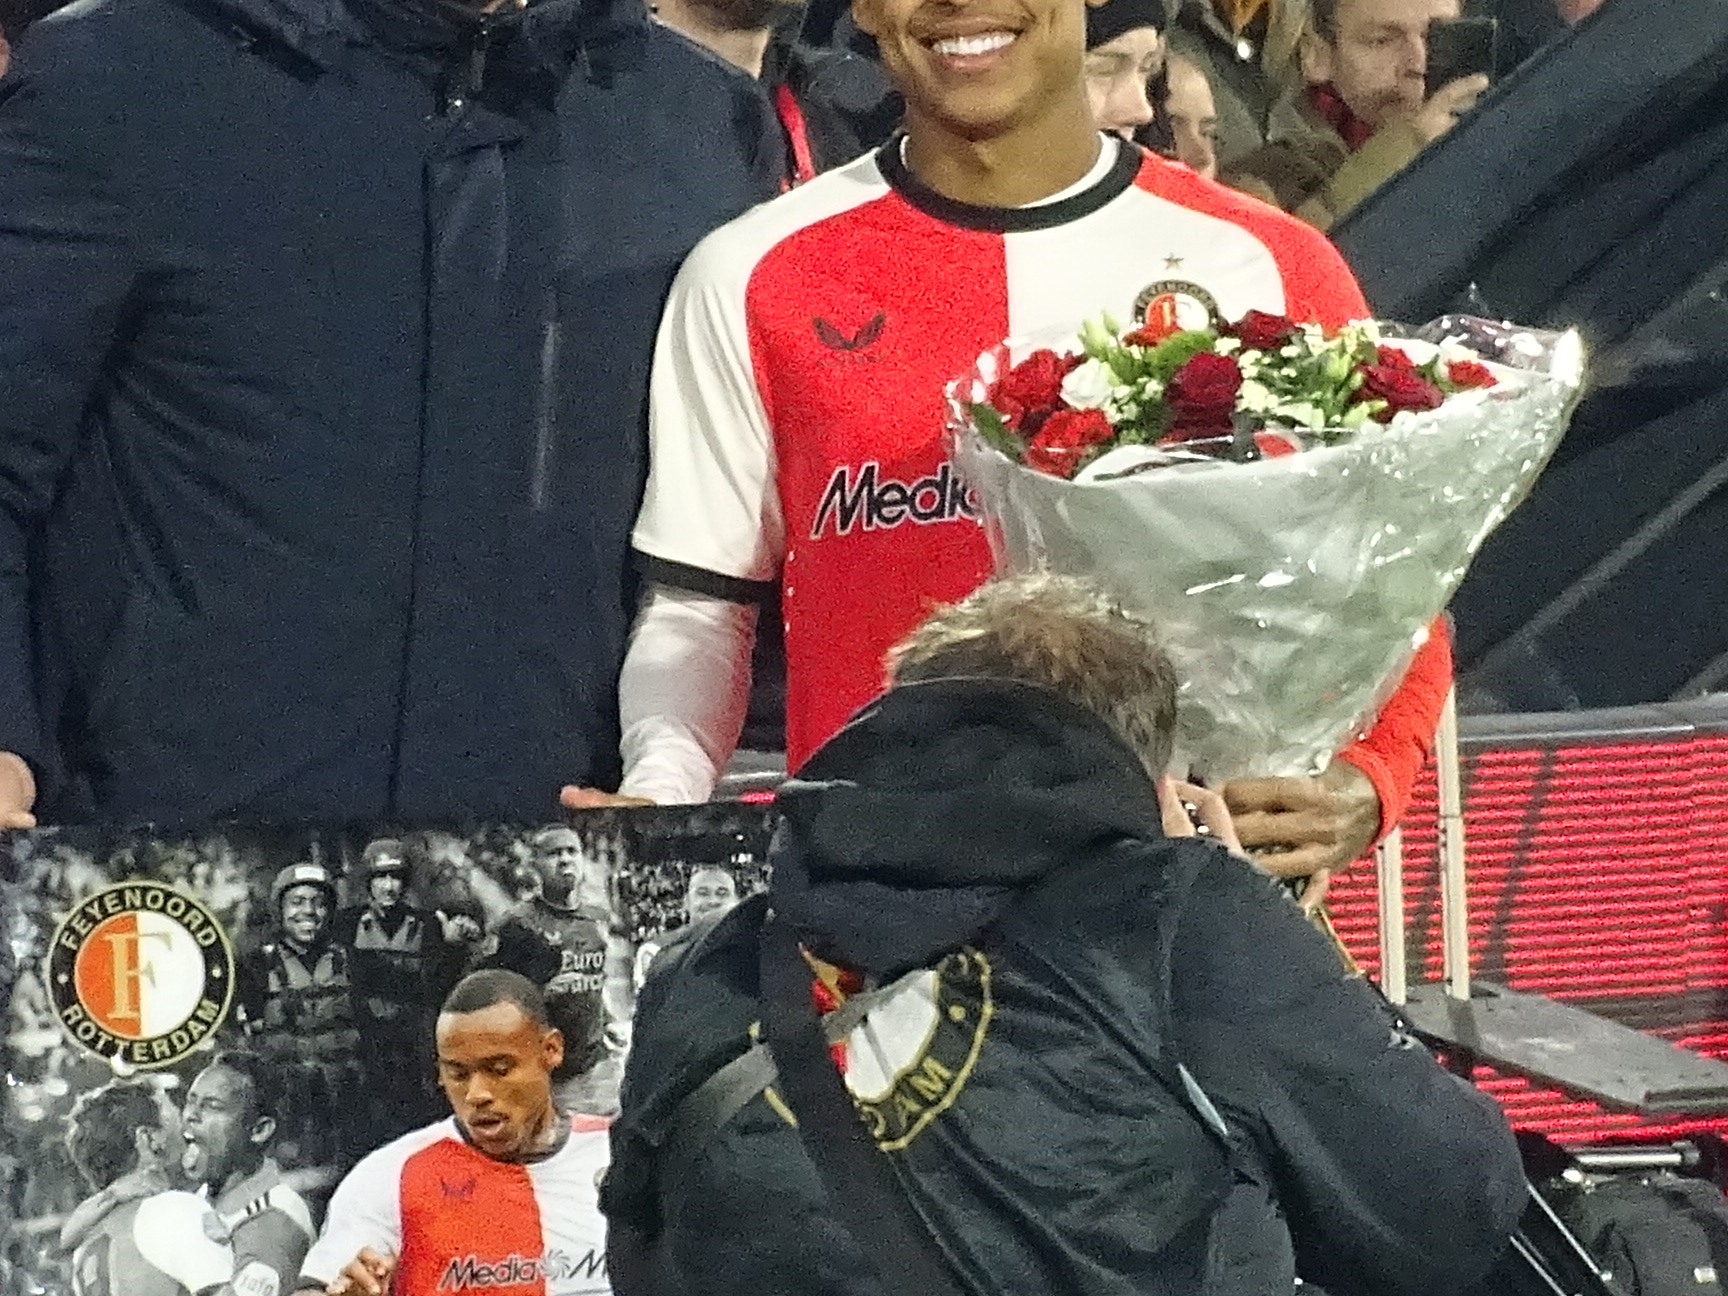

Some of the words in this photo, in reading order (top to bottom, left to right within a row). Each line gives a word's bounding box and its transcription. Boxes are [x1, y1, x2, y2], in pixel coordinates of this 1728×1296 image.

[60, 887, 218, 950] FEYENOORD
[60, 998, 221, 1062] ROTTERDAM
[435, 1255, 538, 1292] Media
